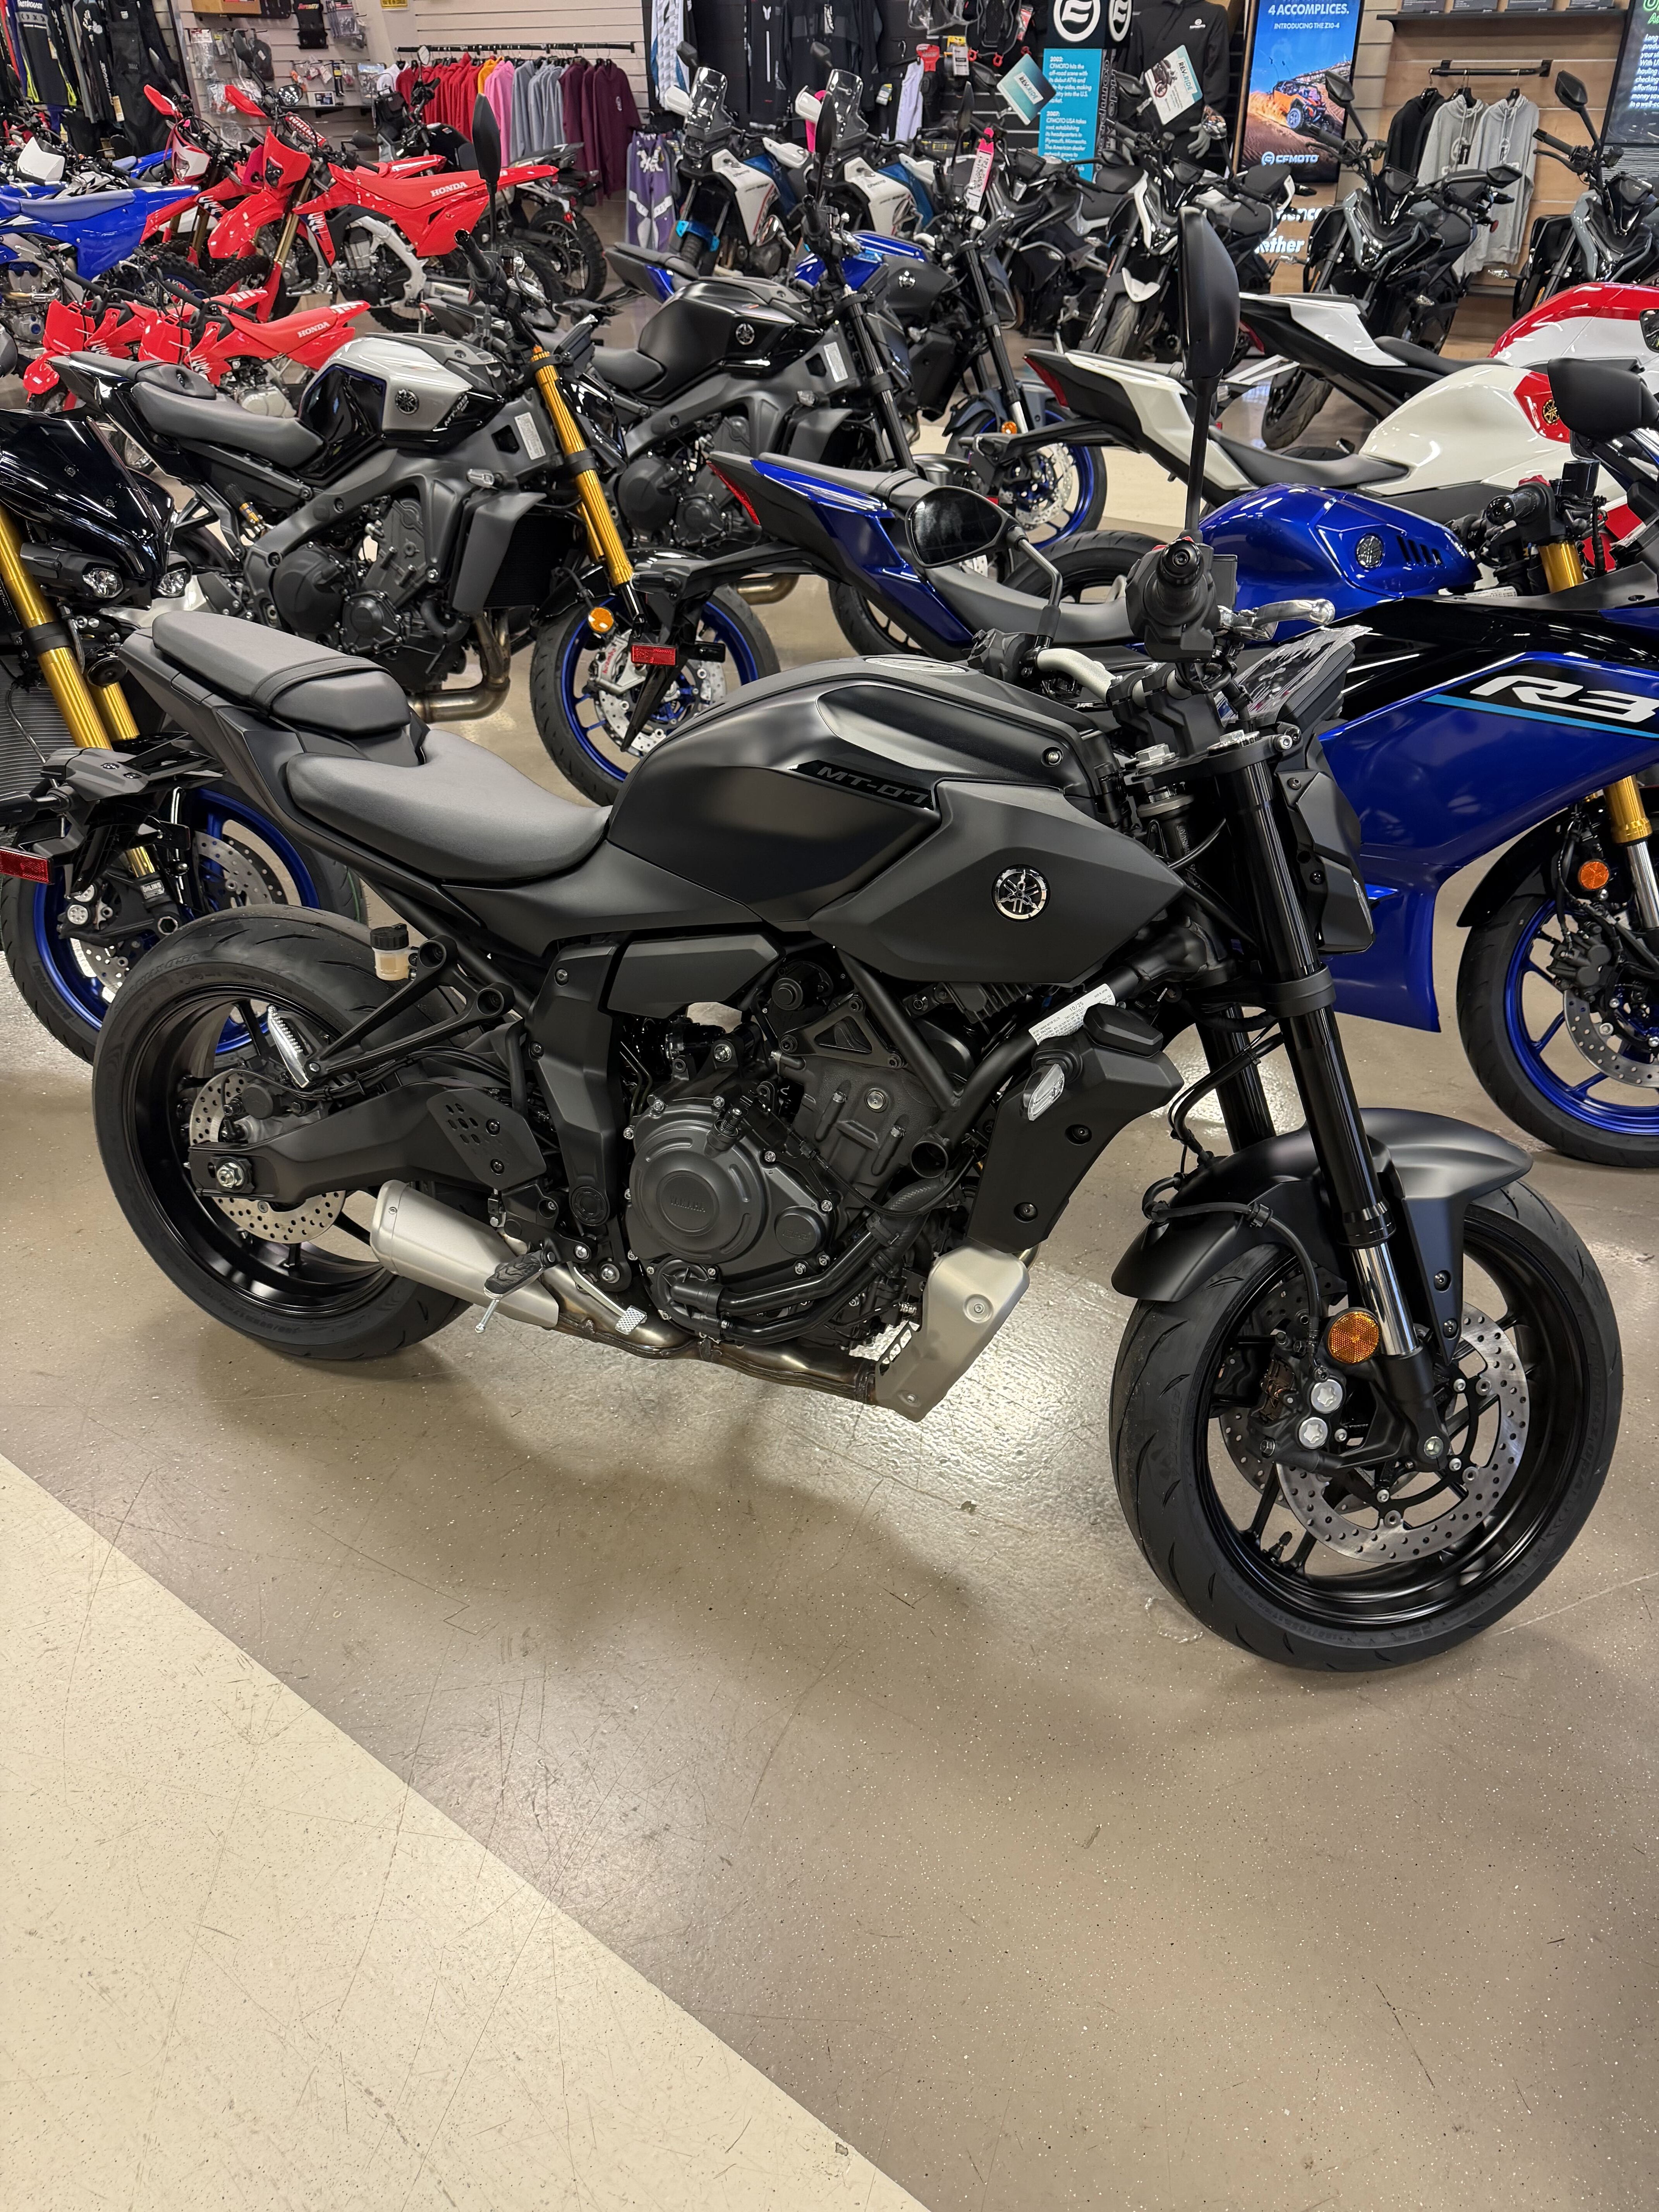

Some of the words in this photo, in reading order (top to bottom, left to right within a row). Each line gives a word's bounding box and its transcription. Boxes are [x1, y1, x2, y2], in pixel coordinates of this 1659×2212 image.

[1268, 5, 1276, 15] 4
[1276, 3, 1350, 15] ACCOMPLICES.
[1276, 155, 1318, 163] CFMOTO
[430, 181, 468, 198] HONDA
[297, 321, 331, 338] HONDA
[1470, 675, 1659, 723] R3
[817, 766, 929, 805] MT-07
[1069, 1001, 1084, 1012] 10/25
